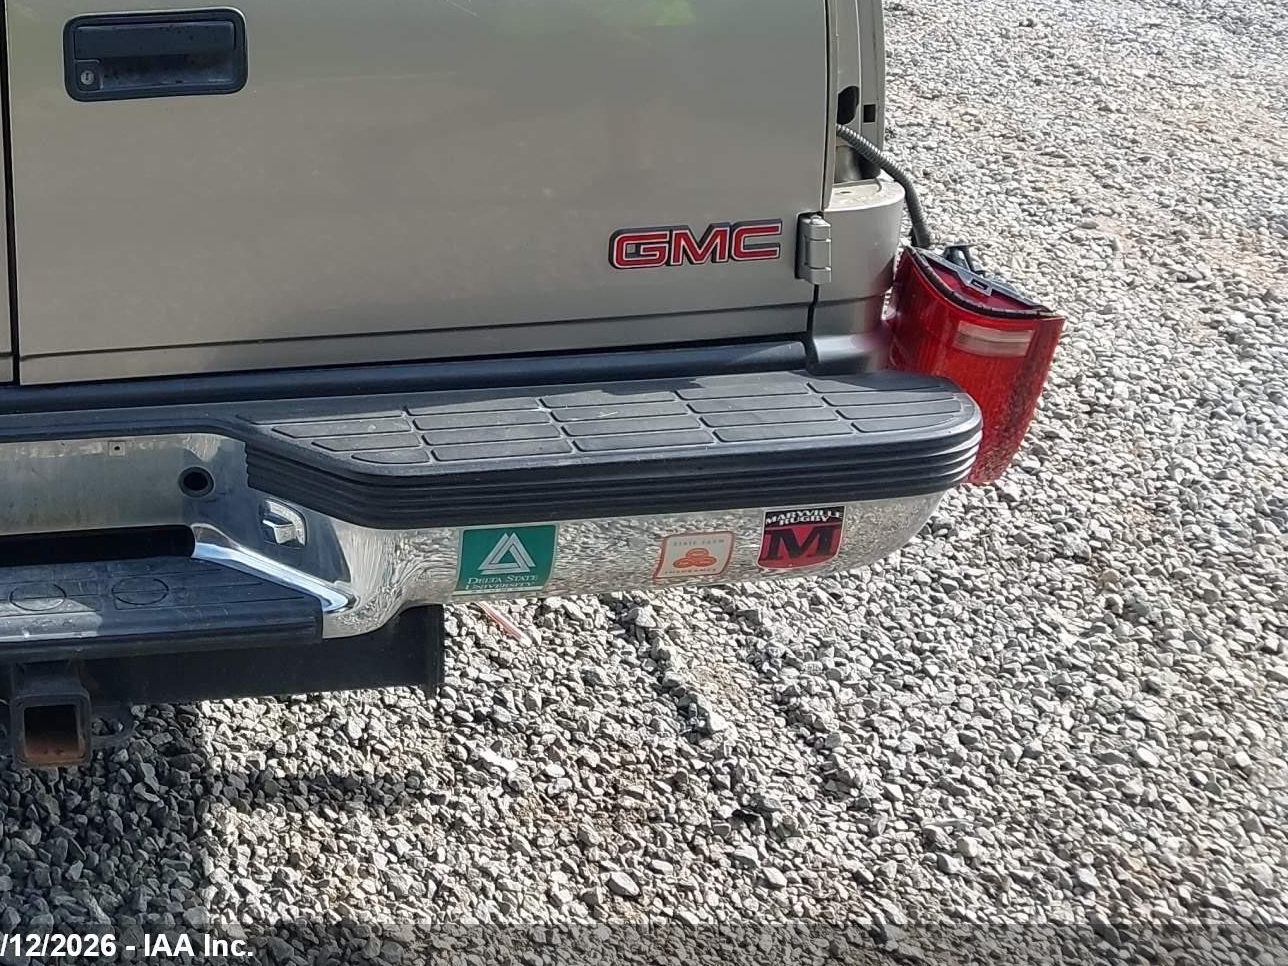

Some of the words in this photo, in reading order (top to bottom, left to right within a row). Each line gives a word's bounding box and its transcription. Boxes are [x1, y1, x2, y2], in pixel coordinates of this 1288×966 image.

[608, 218, 783, 270] GMC
[765, 509, 843, 525] MARYVILLE
[778, 515, 830, 526] RUGBY
[765, 524, 841, 562] M
